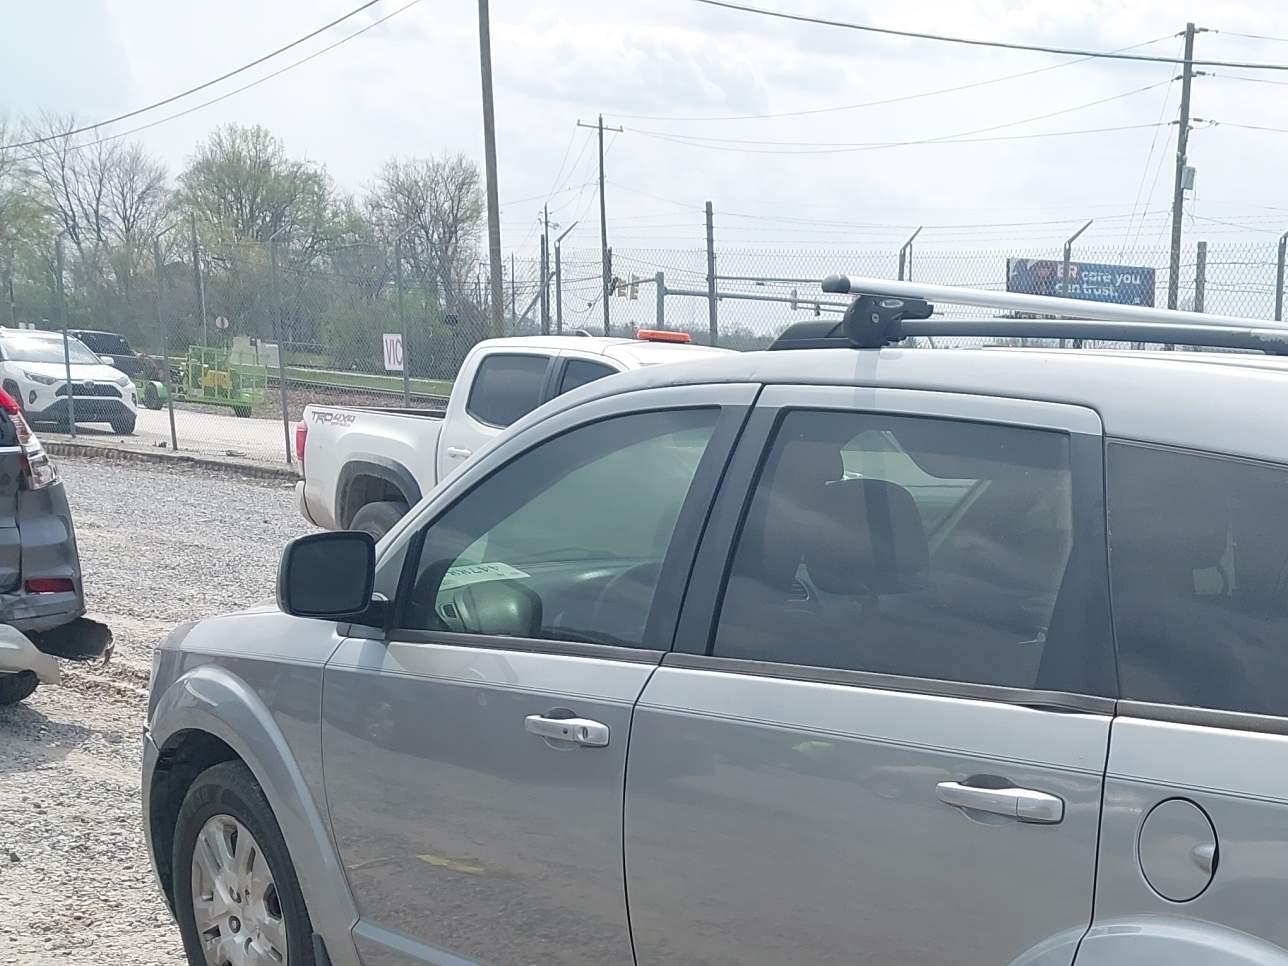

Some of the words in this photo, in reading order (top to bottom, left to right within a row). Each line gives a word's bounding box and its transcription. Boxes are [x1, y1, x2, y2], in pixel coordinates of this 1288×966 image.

[1081, 270, 1112, 282] care
[1115, 272, 1141, 286] you
[1055, 282, 1081, 293] cn
[1082, 284, 1119, 296] trust.
